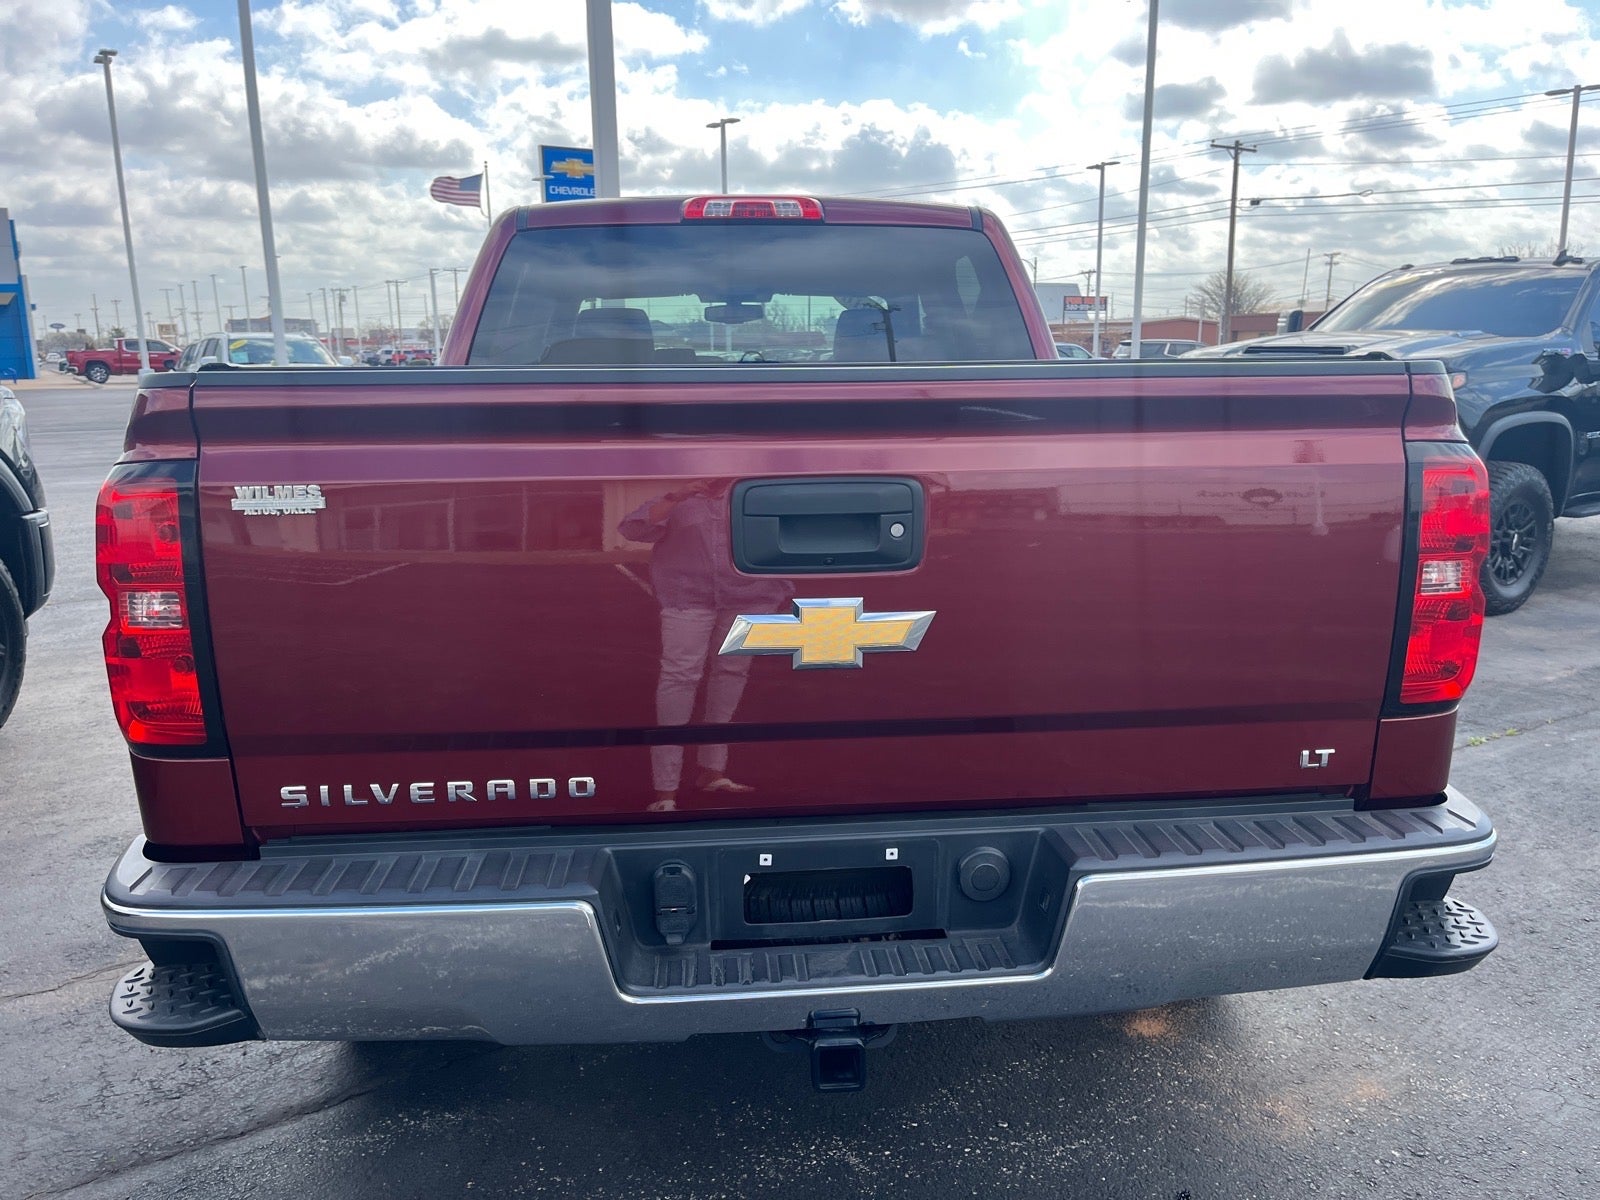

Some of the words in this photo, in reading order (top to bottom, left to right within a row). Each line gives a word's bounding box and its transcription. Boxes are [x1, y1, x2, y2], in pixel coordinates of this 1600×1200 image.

[234, 484, 321, 500] WILMES
[1300, 748, 1336, 768] LT
[280, 776, 597, 808] SILVERADO
